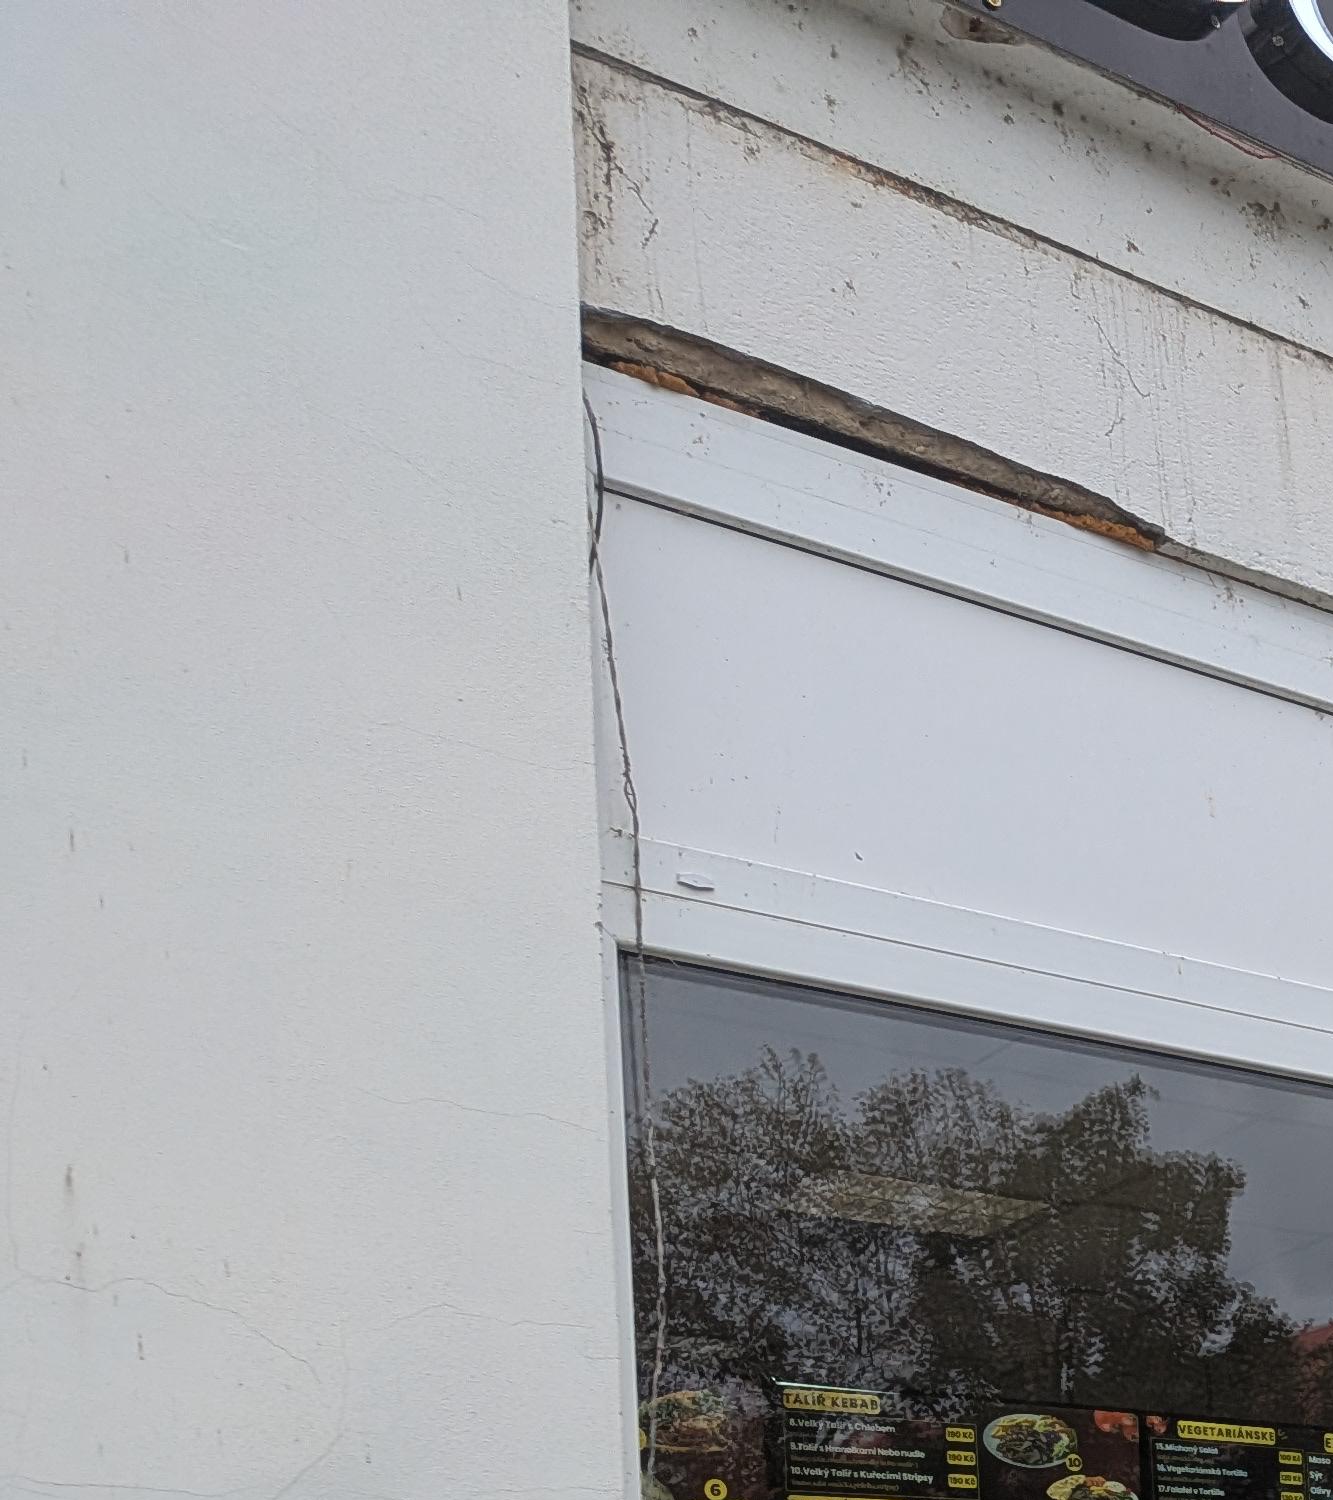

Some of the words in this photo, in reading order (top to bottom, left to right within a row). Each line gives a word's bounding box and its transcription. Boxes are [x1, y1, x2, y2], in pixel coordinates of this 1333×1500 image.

[785, 1392, 826, 1407] TALÍŘ
[831, 1396, 879, 1410] KEBAB
[1068, 1458, 1080, 1468] 10
[711, 1484, 721, 1497] 6
